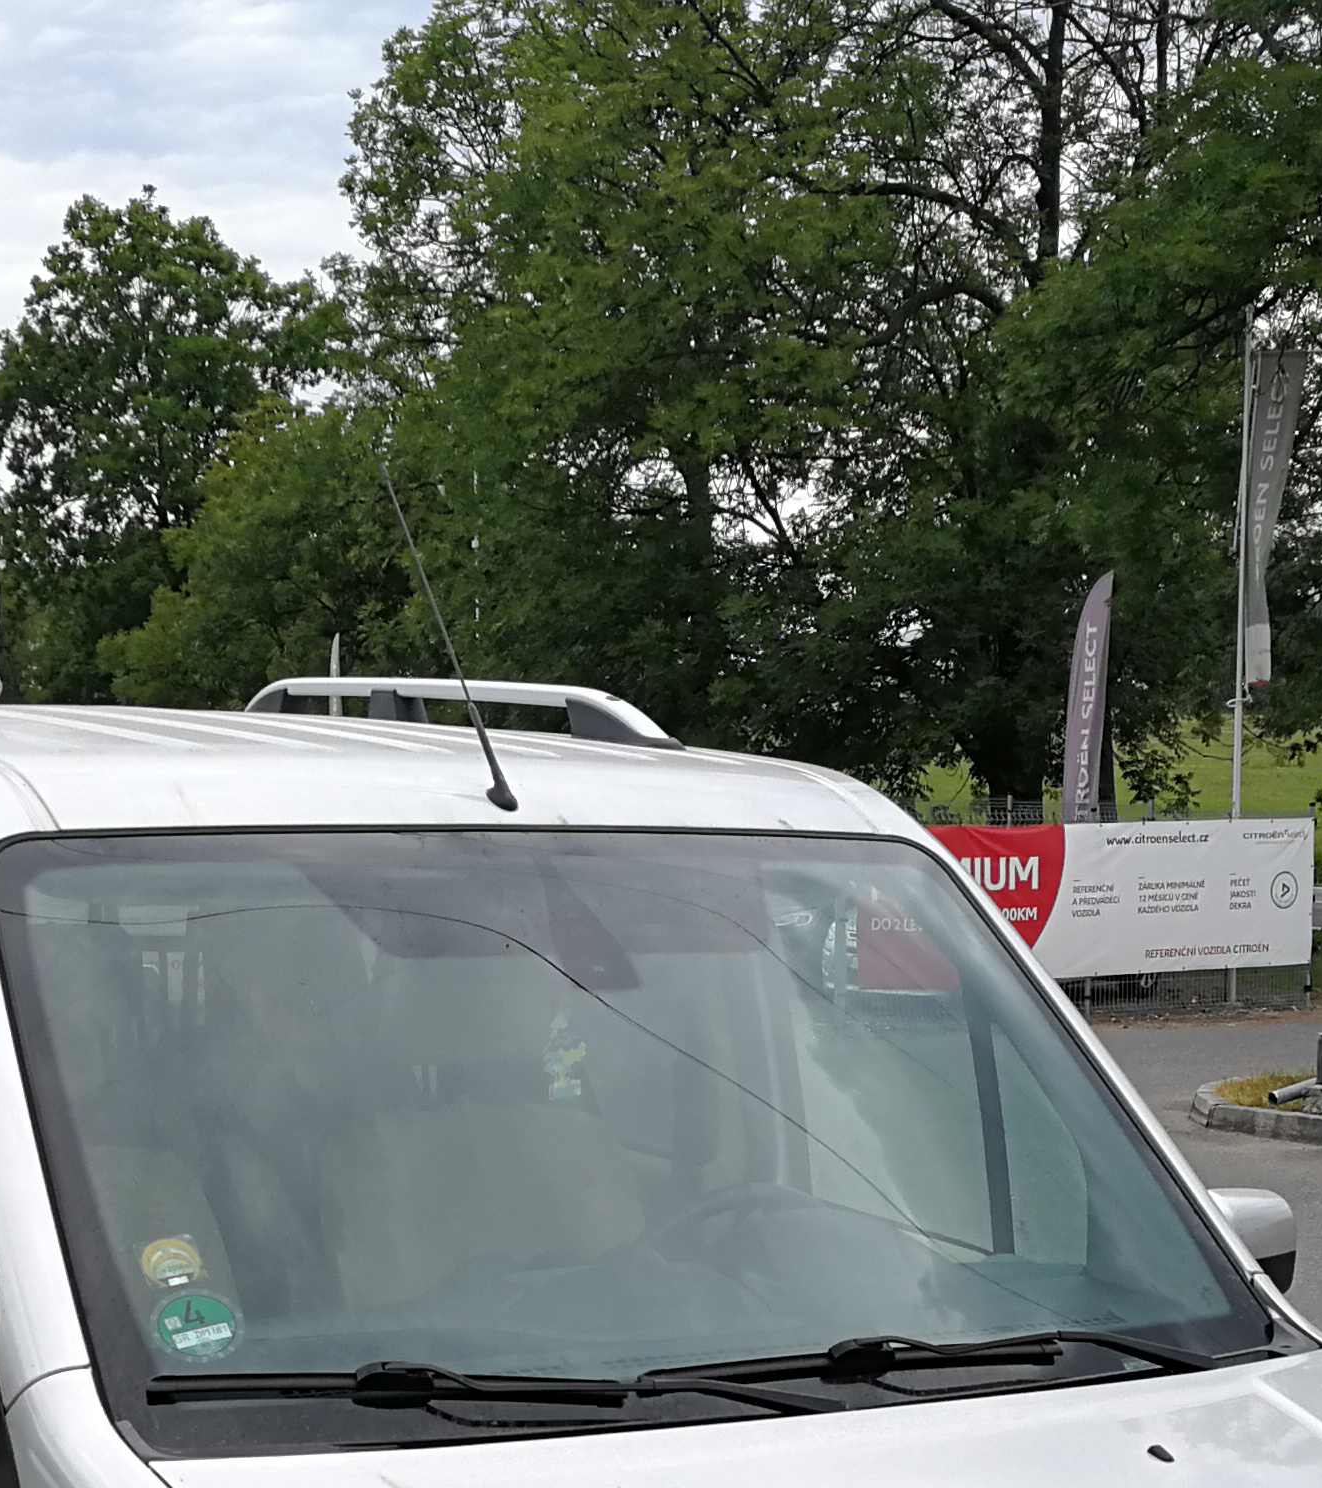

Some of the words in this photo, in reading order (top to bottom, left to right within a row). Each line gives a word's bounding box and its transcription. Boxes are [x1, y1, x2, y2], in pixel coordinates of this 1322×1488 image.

[1081, 621, 1098, 720] SELECT
[1106, 831, 1209, 845] www.citroenselect.cz
[871, 917, 891, 931] DO
[893, 918, 901, 931] 2
[1145, 944, 1197, 958] REFERENČNÍ
[1198, 945, 1231, 955] VOZIDLA
[184, 1299, 206, 1327] 4
